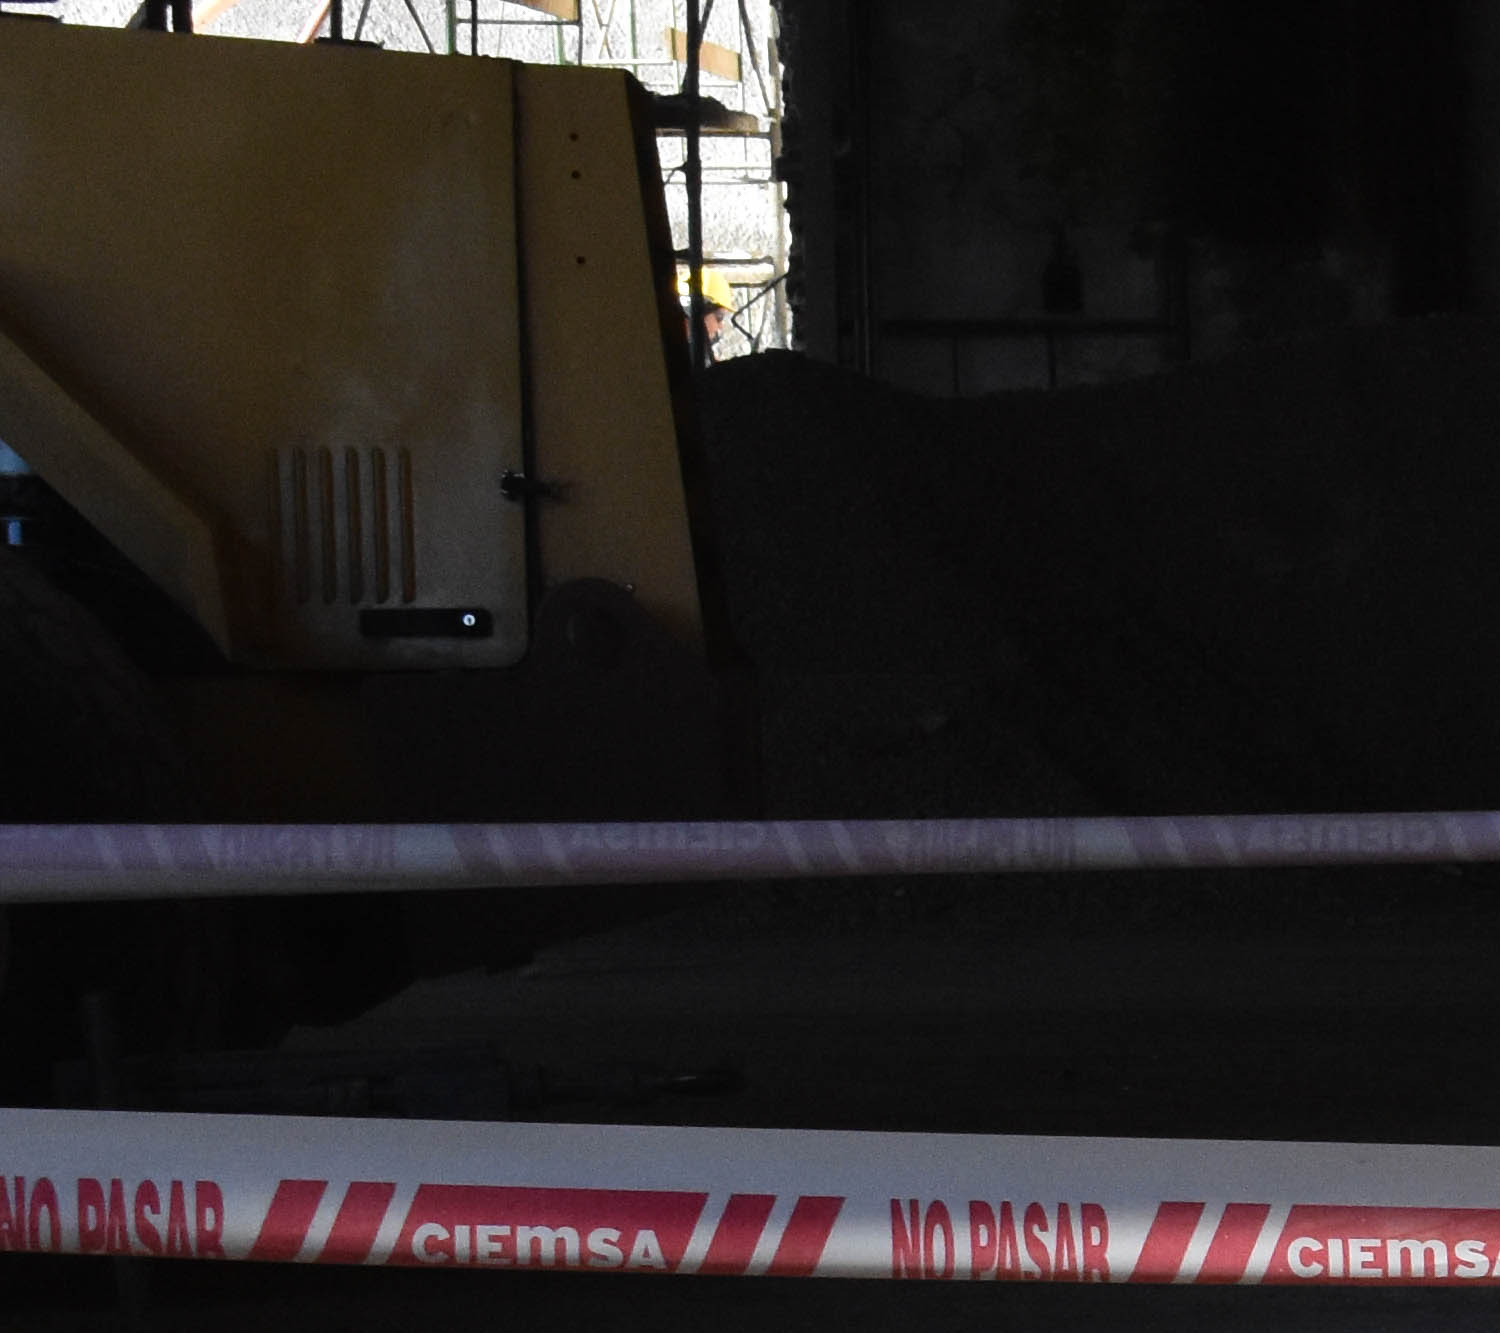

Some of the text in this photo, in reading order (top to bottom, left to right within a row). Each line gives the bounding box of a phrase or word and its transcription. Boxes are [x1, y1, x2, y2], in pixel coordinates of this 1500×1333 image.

[78, 1177, 227, 1259] PASAR
[890, 1198, 1111, 1283] NO PASAR
